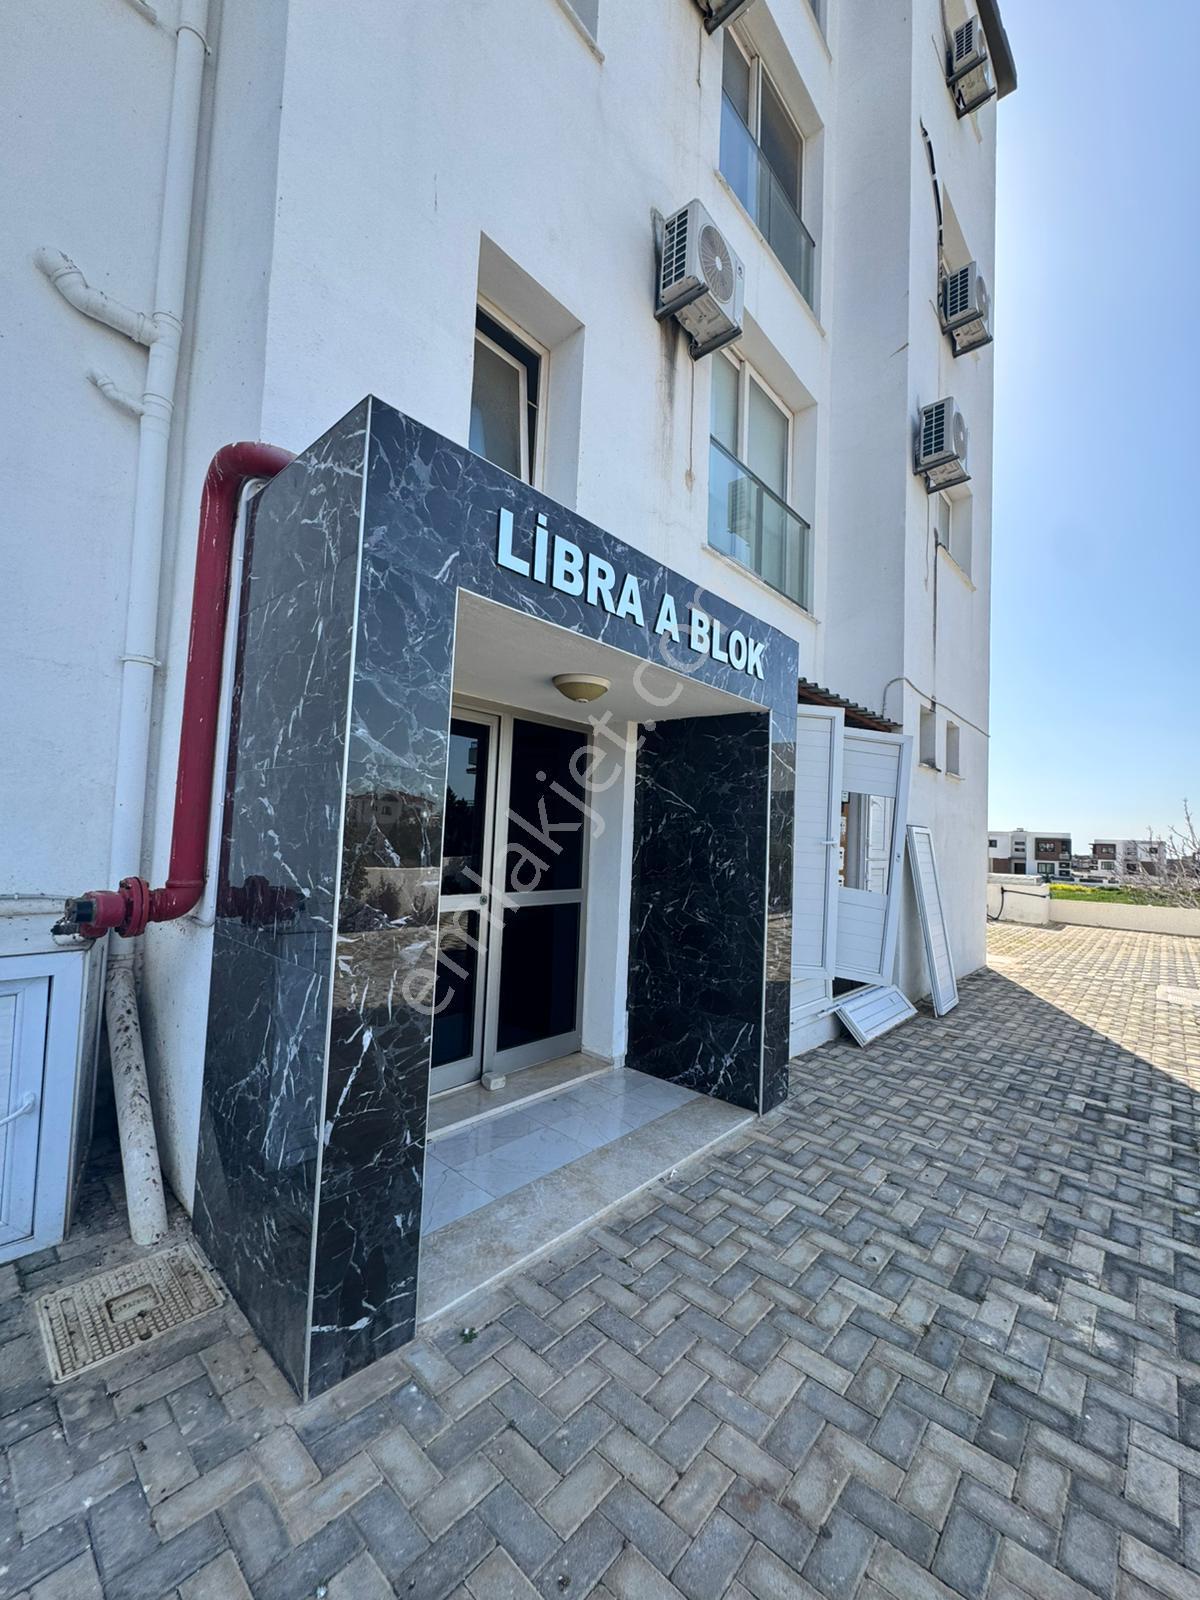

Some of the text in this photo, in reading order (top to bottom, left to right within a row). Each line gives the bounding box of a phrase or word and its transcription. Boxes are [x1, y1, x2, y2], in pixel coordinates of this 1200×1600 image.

[497, 507, 766, 680] LİBRA A BLOK
